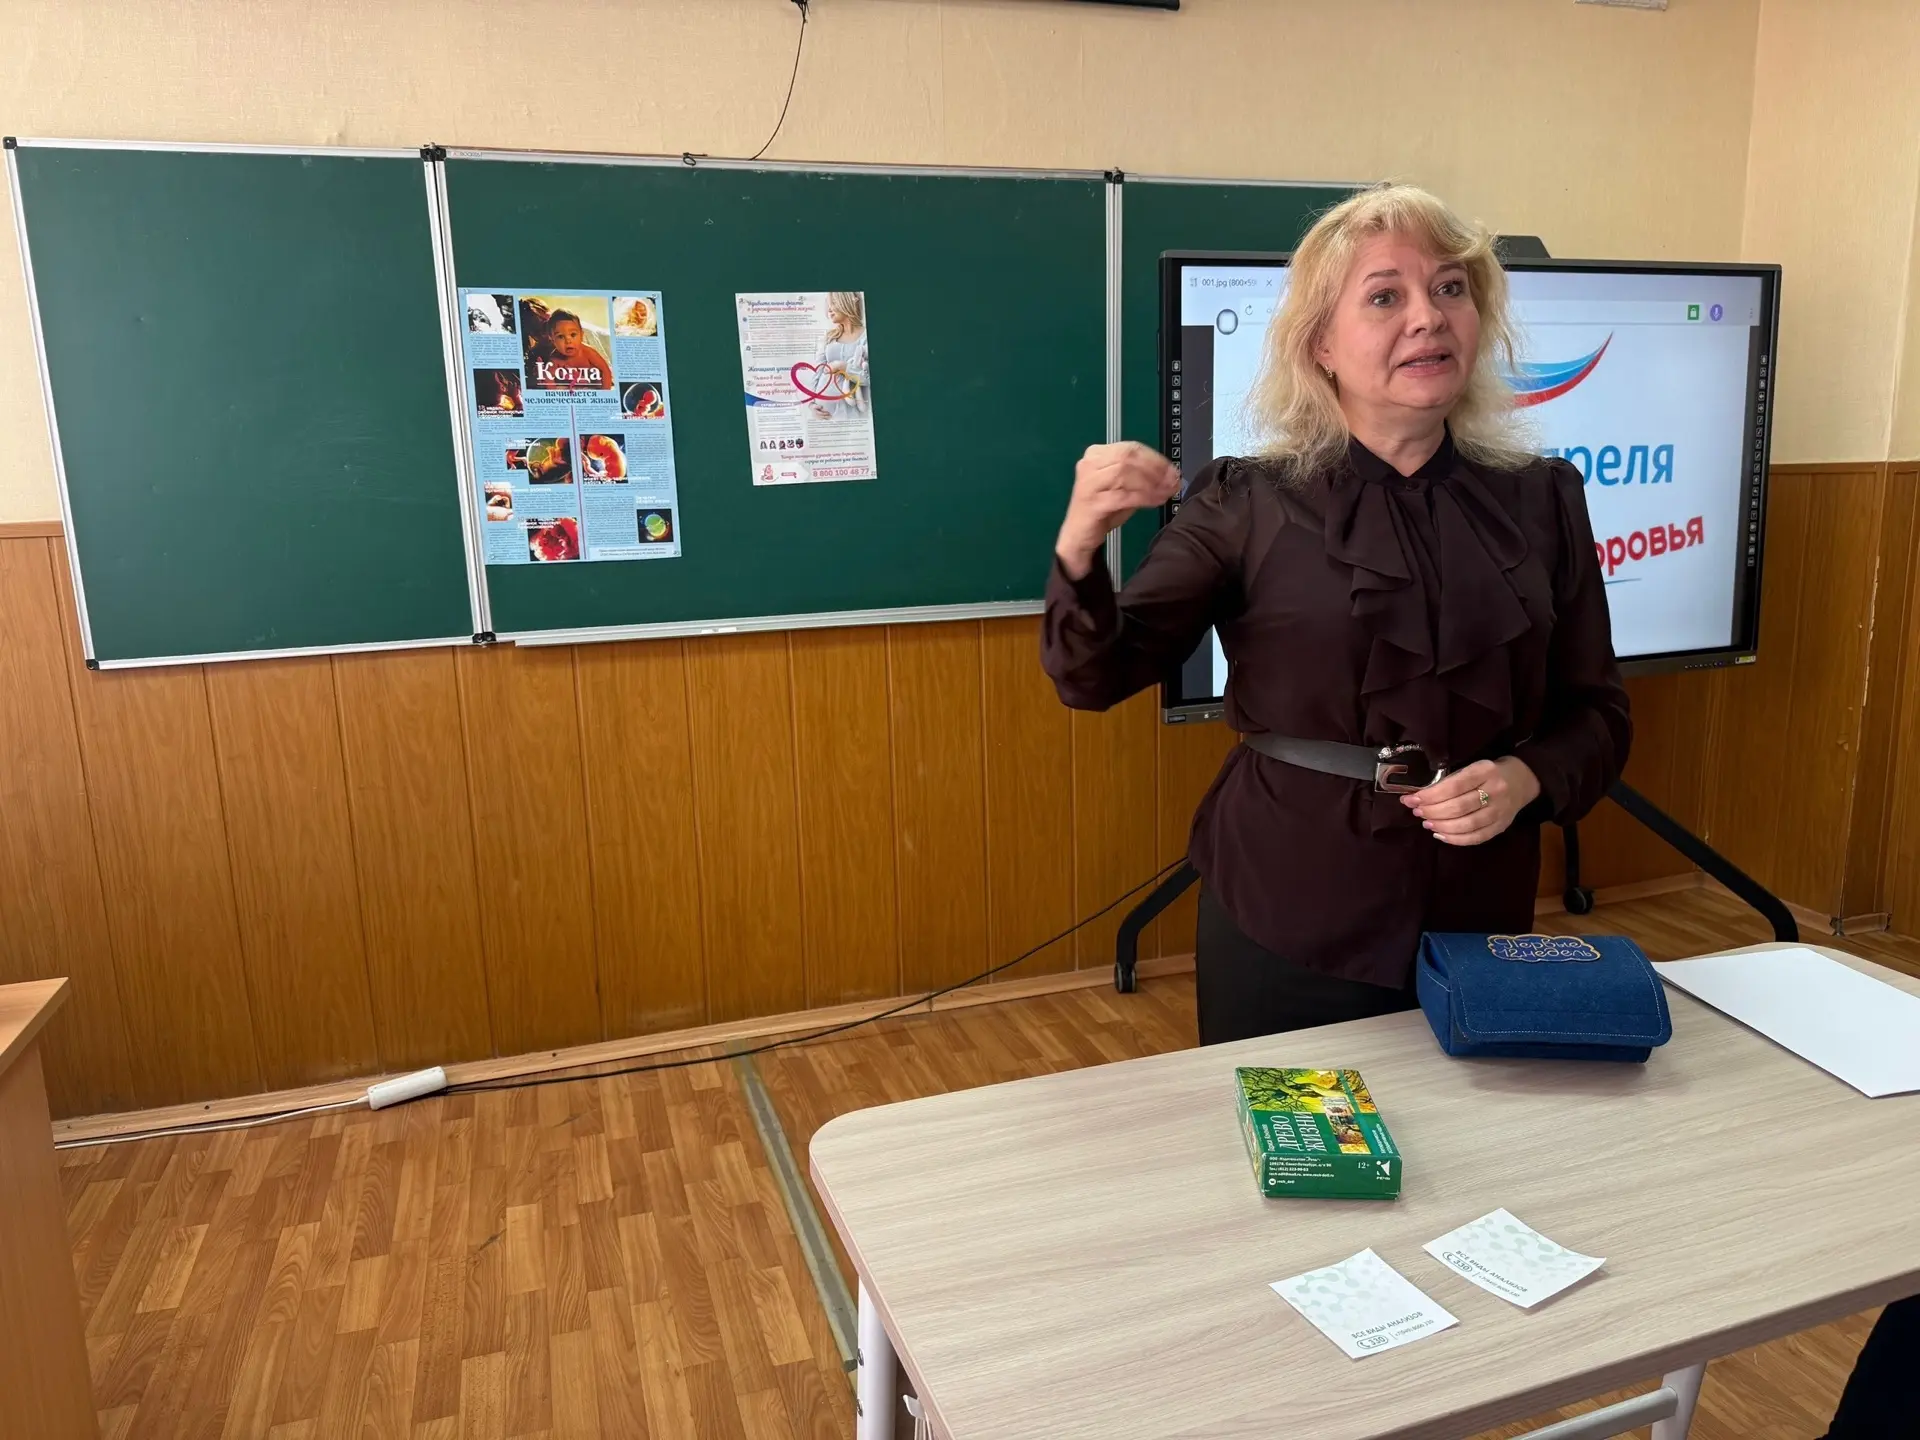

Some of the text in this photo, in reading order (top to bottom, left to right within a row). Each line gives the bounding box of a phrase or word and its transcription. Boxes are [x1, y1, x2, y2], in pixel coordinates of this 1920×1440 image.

[1202, 278, 1228, 288] 001.jpg
[535, 361, 602, 384] Когда
[1494, 937, 1582, 951] Первые
[1499, 947, 1592, 958] 12 недель
[1270, 1115, 1304, 1151] ДРЕВО
[1293, 1110, 1328, 1152] ЖИЗНИ
[1358, 1161, 1370, 1169] 12+
[1453, 1259, 1470, 1271] 330
[1456, 1250, 1528, 1293] ВСЕ ВИДЫ АНАЛИЗОВ
[1351, 1311, 1423, 1339] ВСЕ ВИДЫ АНАЛИЗОВ
[1368, 1336, 1386, 1346] 330
